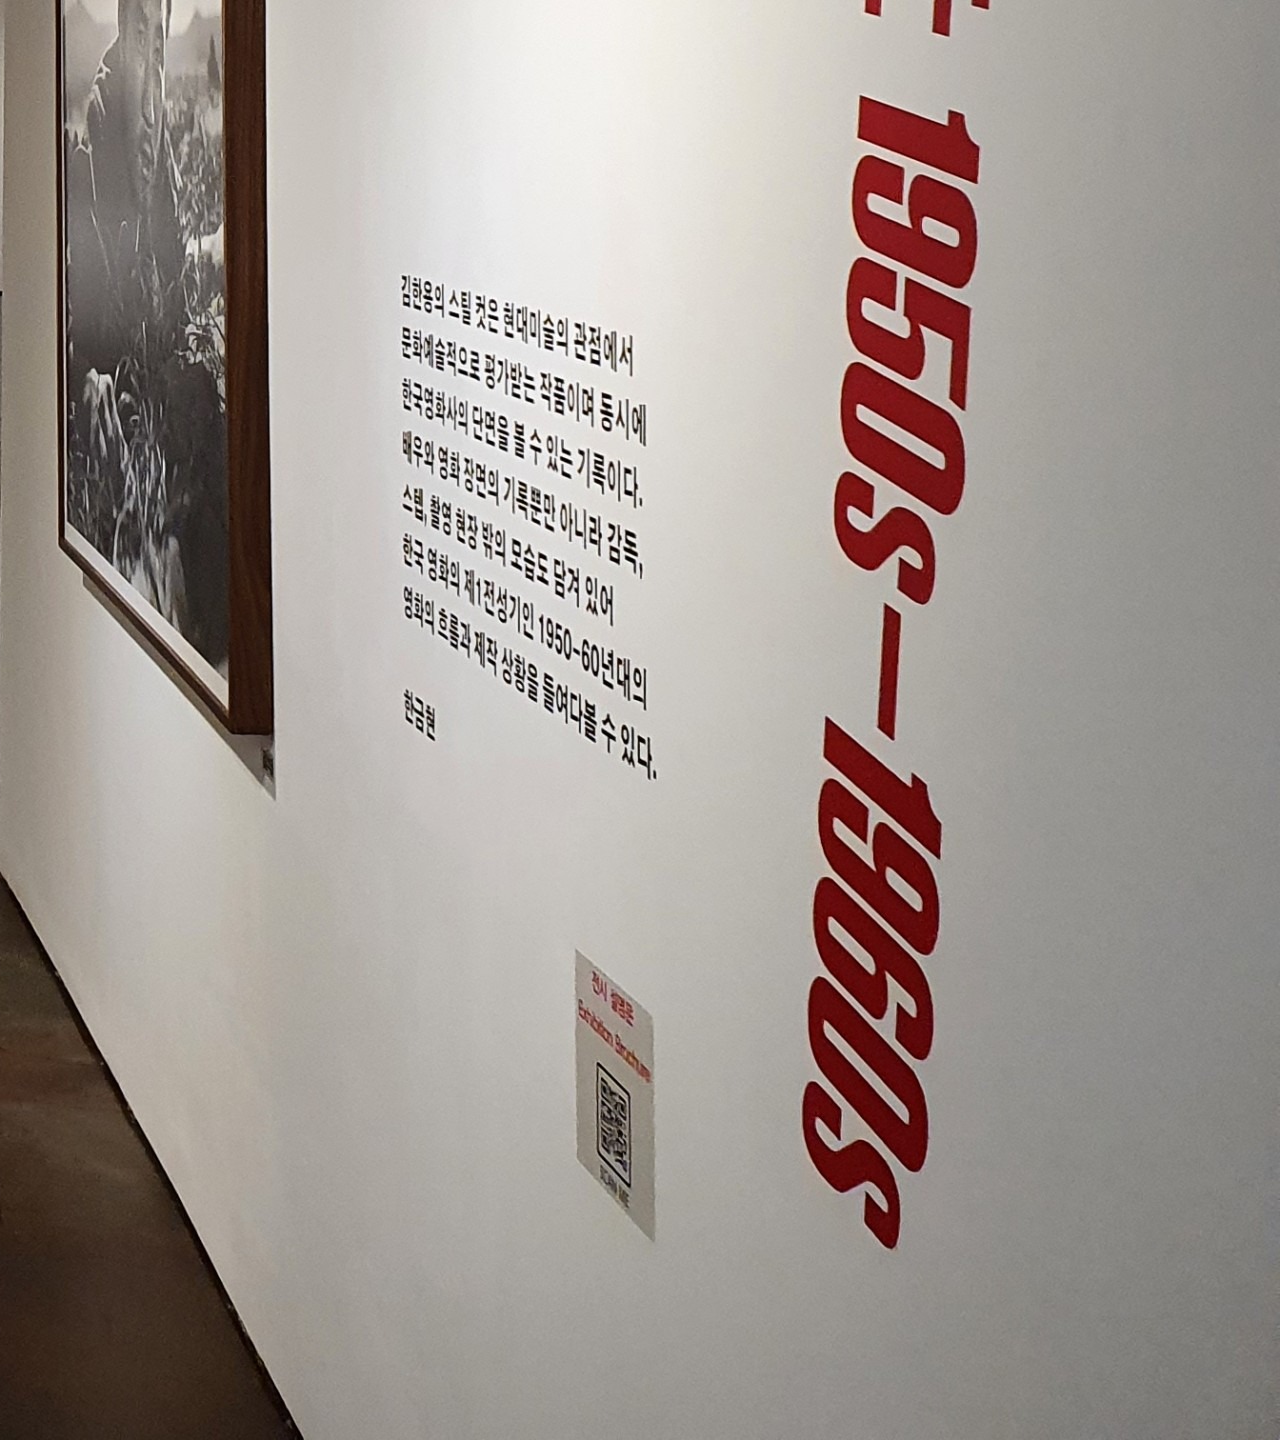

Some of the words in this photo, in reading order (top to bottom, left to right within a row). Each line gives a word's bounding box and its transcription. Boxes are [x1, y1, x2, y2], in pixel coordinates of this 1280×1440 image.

[401, 274, 445, 319] 김한용의
[447, 289, 472, 326] 스틸
[475, 294, 500, 335] 컷은
[502, 301, 569, 357] 현대미술의
[573, 321, 634, 378] 관점에서
[401, 326, 481, 382] 문화예술적으로
[483, 353, 537, 405] 평가받는
[539, 371, 595, 428] 작품이며
[599, 391, 647, 448] 동시에
[401, 377, 469, 436] 한국영화사의
[471, 405, 510, 453] 단면을
[512, 420, 526, 460] 볼
[528, 428, 543, 466] 수
[545, 434, 574, 480] 있는
[576, 447, 643, 510] 기록이다.
[402, 430, 435, 476] 배우와
[437, 446, 461, 488] 영화
[463, 456, 500, 507] 장면의
[503, 476, 556, 533] 기록뿐만
[559, 502, 603, 558] 아니라
[402, 532, 425, 576] 한국
[427, 547, 461, 598] 영화의
[455, 507, 479, 551] 현장
[481, 520, 507, 568] 밖의
[510, 537, 550, 587] 모습도
[553, 558, 580, 609] 담겨
[585, 575, 614, 627] 있어
[403, 585, 435, 636] 영화의
[437, 607, 472, 659] 흐름과
[473, 630, 499, 678] 제작
[500, 647, 540, 704] 상황을
[541, 672, 598, 744] 들여다볼
[600, 713, 617, 754] 수
[620, 723, 657, 781] 있다.
[403, 688, 436, 742] 한금현
